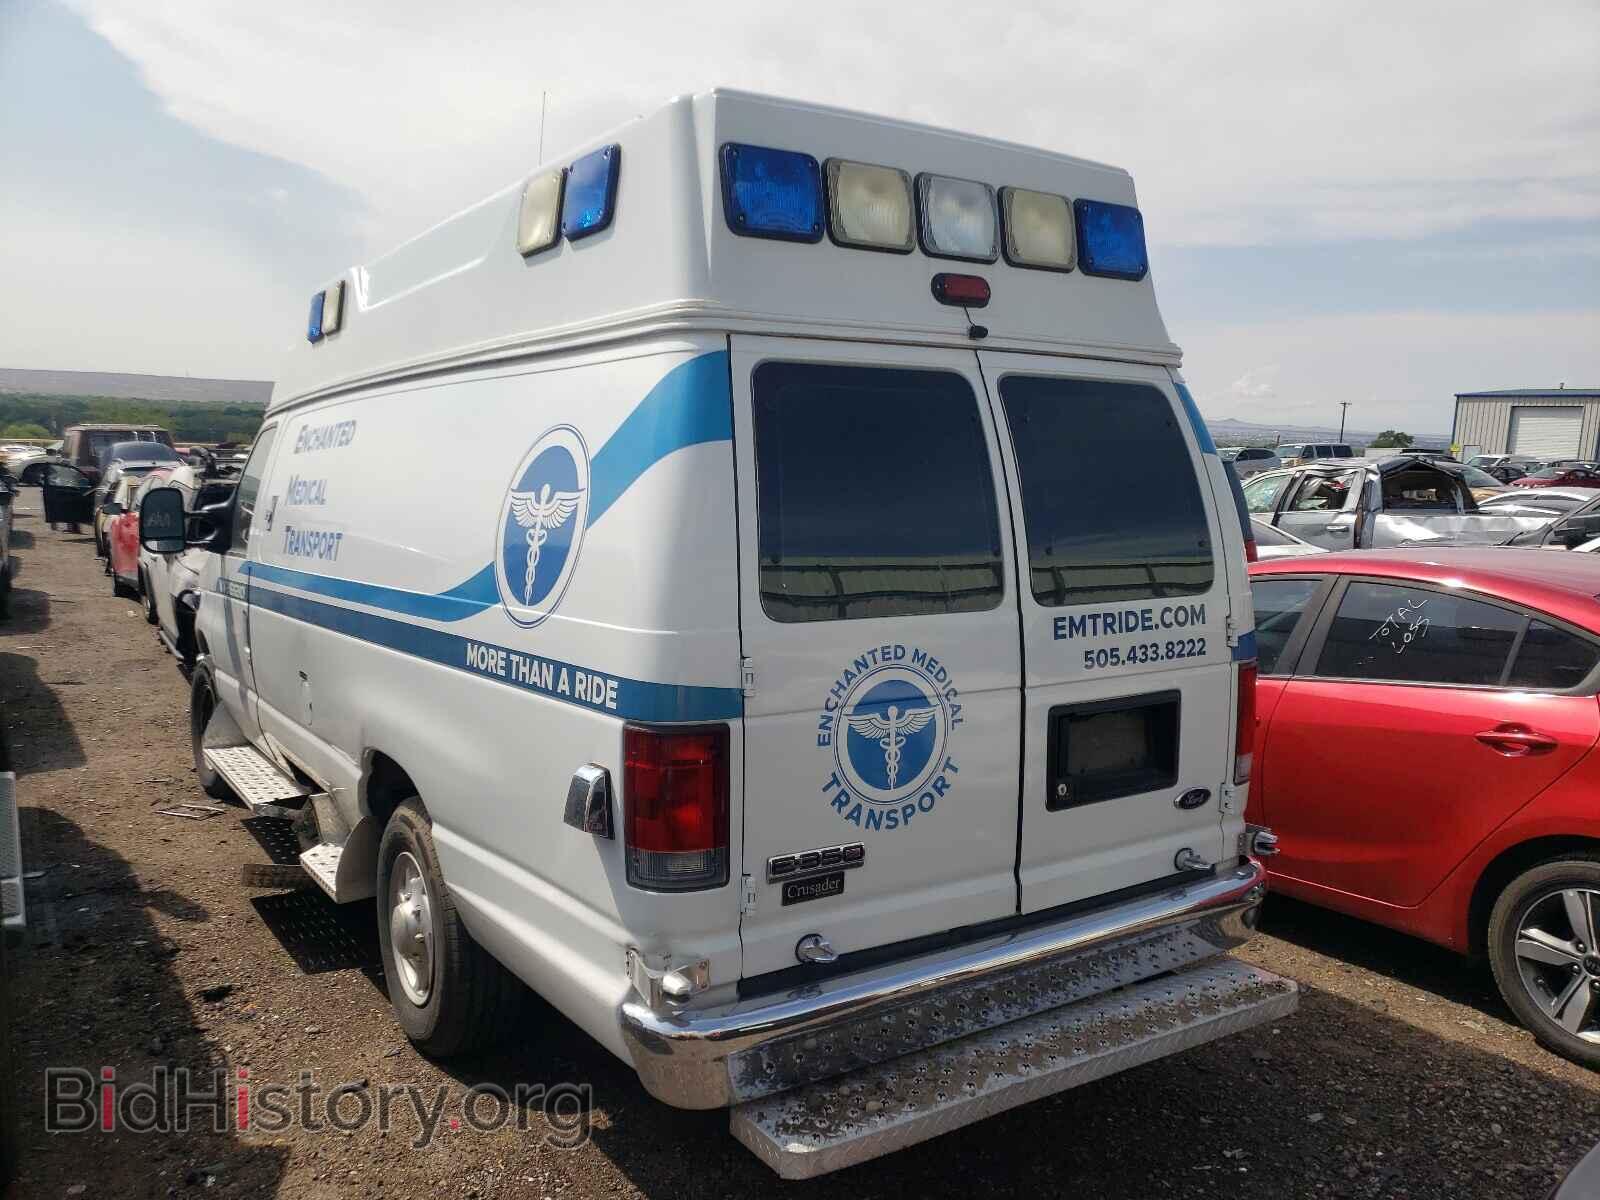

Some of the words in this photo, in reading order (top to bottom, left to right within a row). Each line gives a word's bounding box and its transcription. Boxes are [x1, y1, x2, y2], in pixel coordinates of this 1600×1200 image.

[293, 419, 357, 455] ENCHANTED
[284, 473, 327, 506] MEDICAL
[283, 525, 344, 562] TRANSPORT
[1053, 603, 1206, 641] EMTRIDE.COM
[1084, 637, 1207, 670] 505.433.8222
[466, 642, 507, 677] MORE
[509, 653, 554, 691] THAN
[557, 667, 570, 696] A
[574, 671, 618, 710] RIDE
[817, 644, 906, 747] ENCHANTED
[911, 648, 963, 730] MEDICAL
[822, 756, 959, 831] TRANSPORT
[787, 877, 841, 899] Crusader
